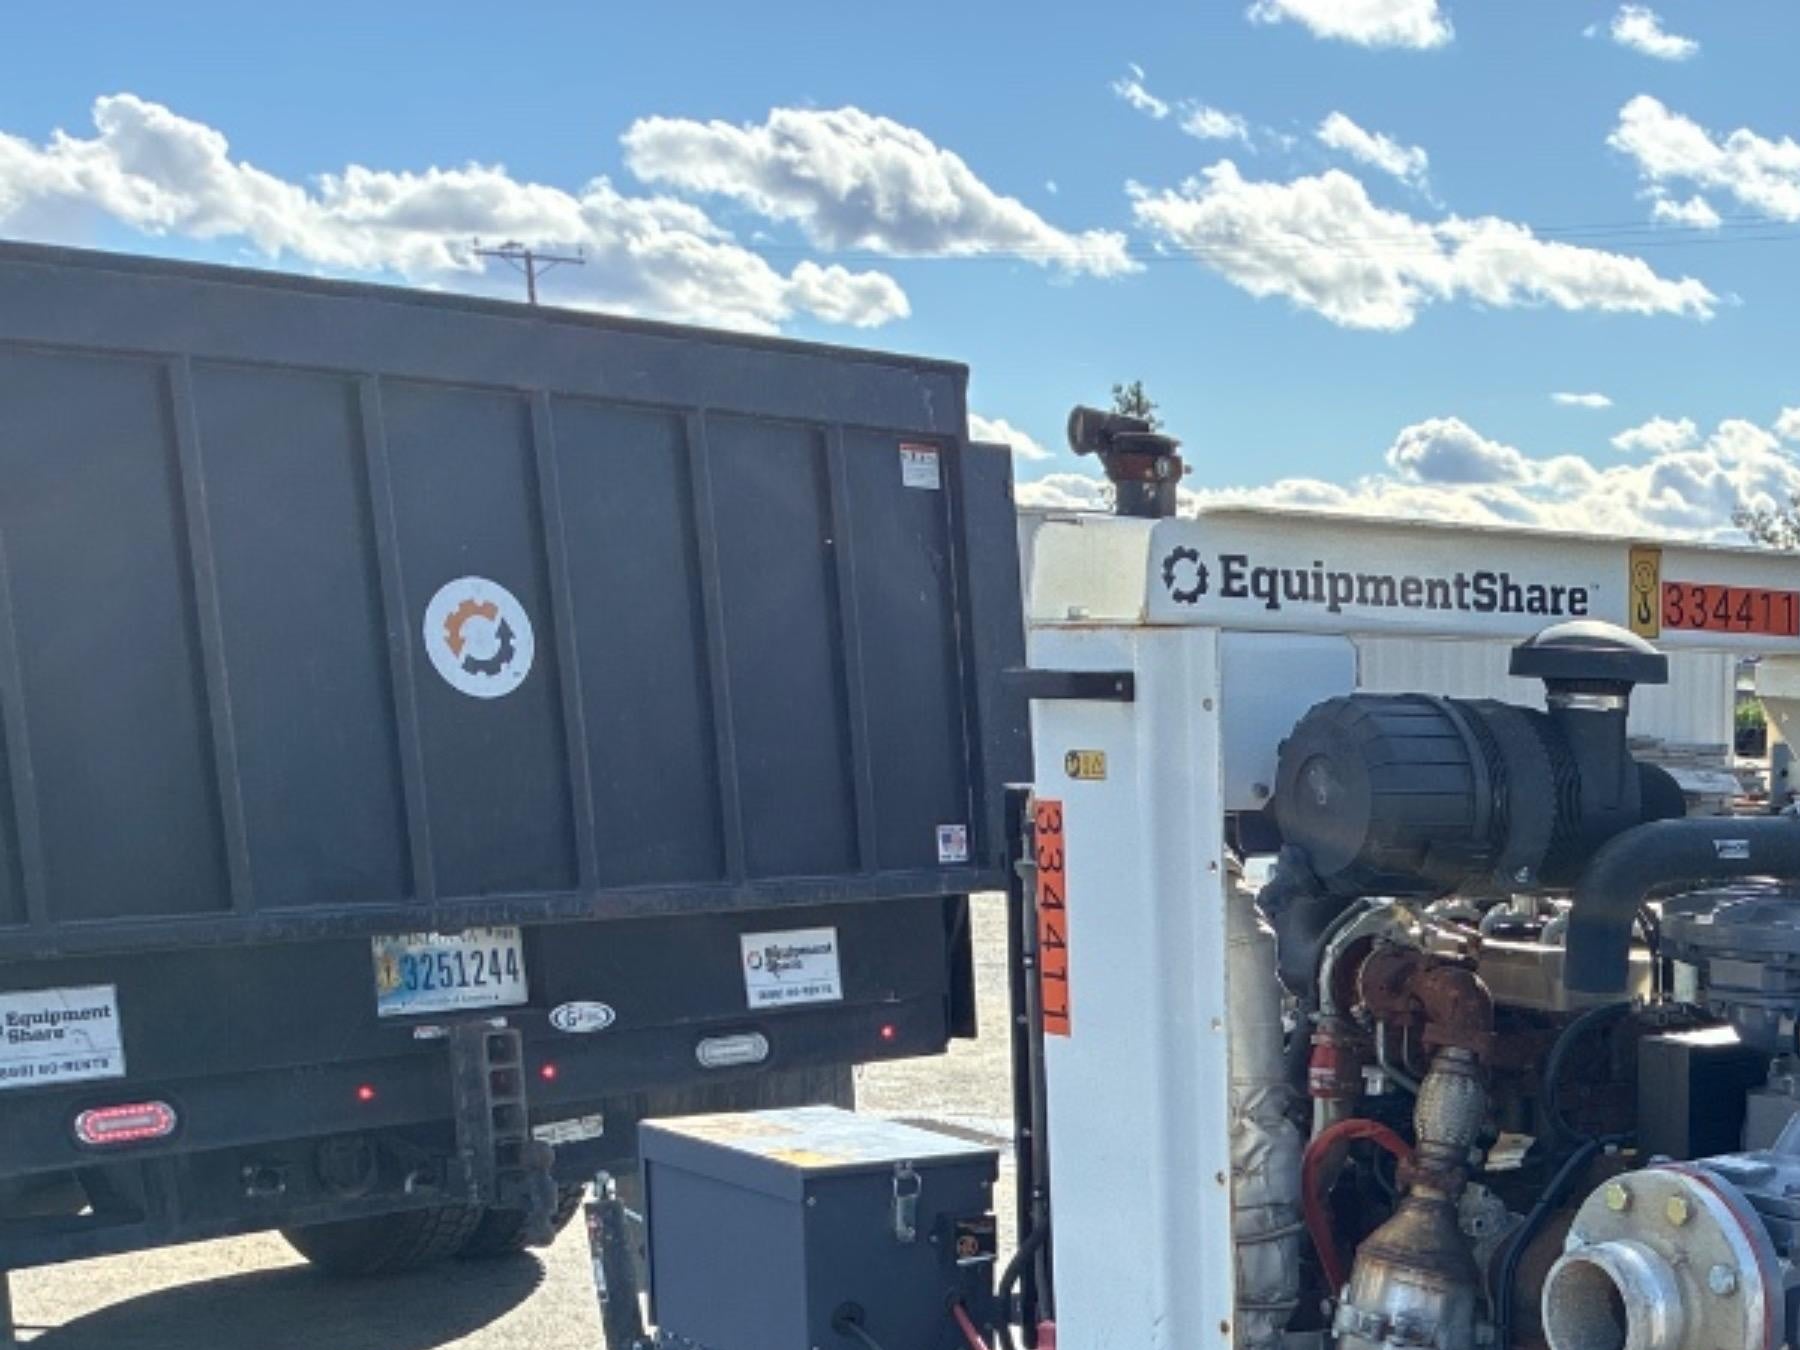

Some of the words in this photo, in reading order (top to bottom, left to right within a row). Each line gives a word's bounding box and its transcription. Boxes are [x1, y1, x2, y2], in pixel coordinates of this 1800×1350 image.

[1218, 553, 1589, 617] EquipmentShare
[1664, 582, 1797, 635] 334411
[1037, 806, 1069, 1022] 334411
[402, 947, 520, 991] 3251244
[5, 1004, 112, 1028] Equipment
